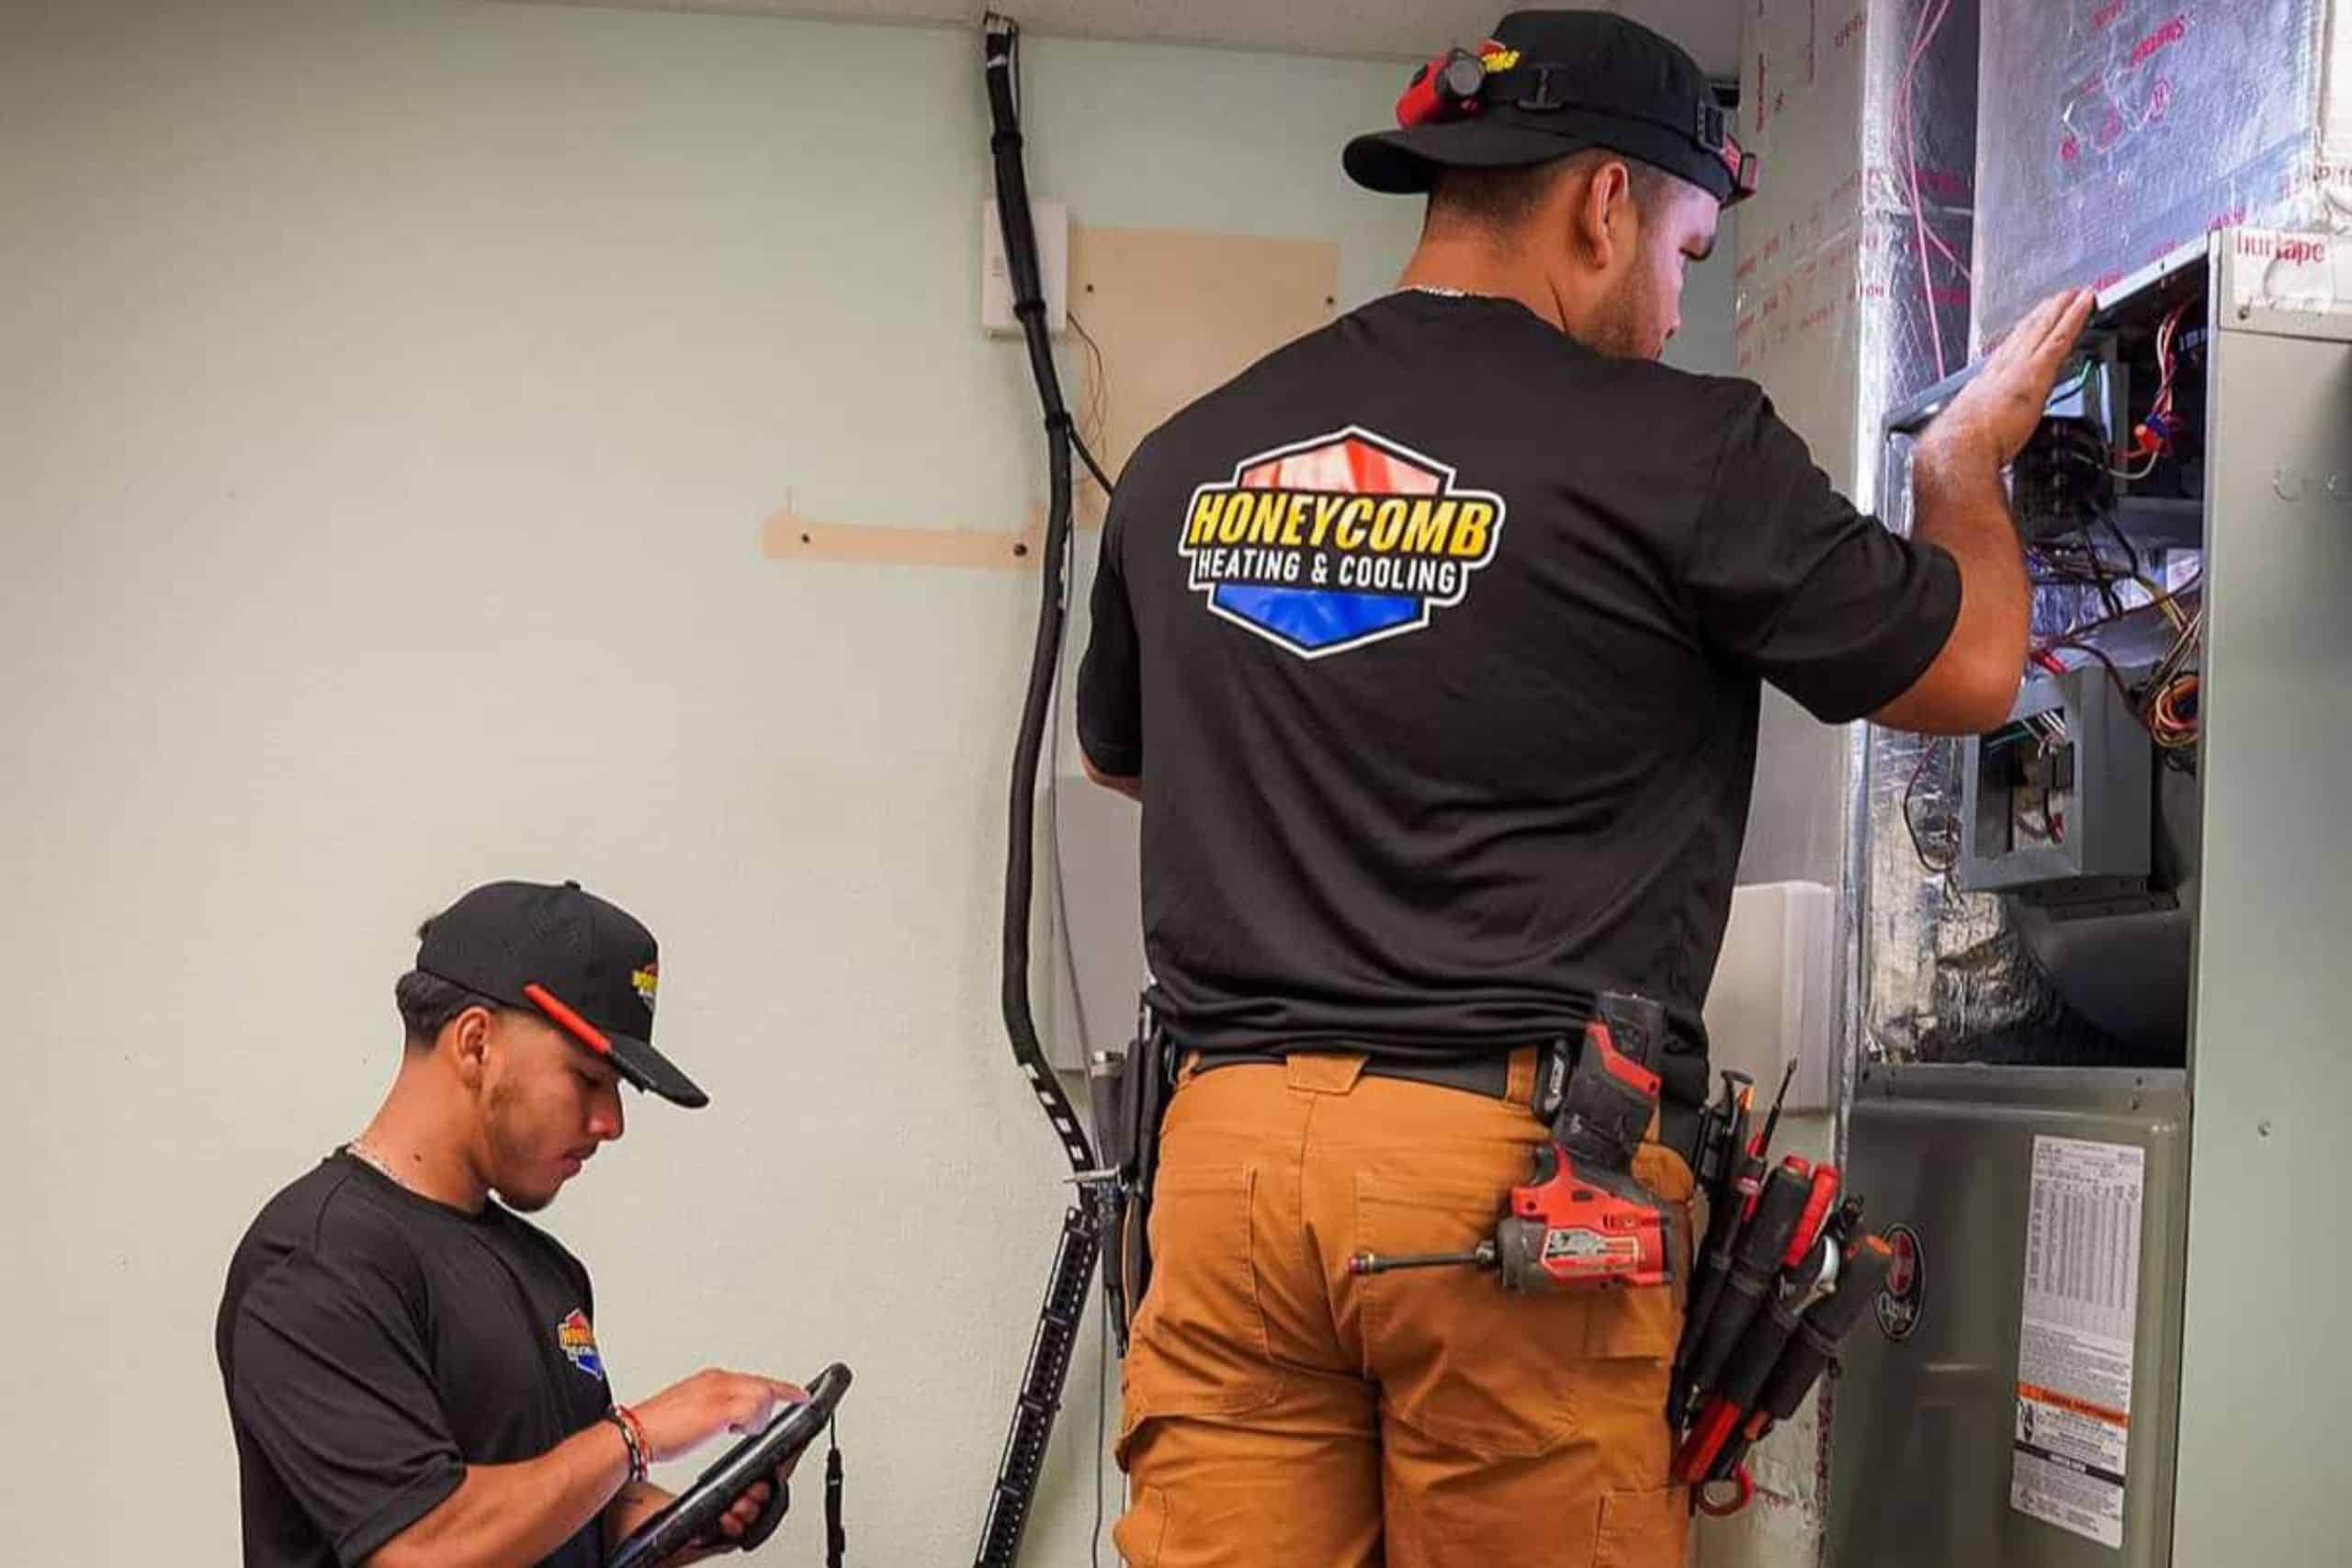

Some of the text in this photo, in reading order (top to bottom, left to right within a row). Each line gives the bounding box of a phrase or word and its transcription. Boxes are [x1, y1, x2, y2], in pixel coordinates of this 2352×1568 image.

[1189, 493, 1494, 557] HONEYCOMB
[1198, 548, 1457, 594] HEATING & COOLING
